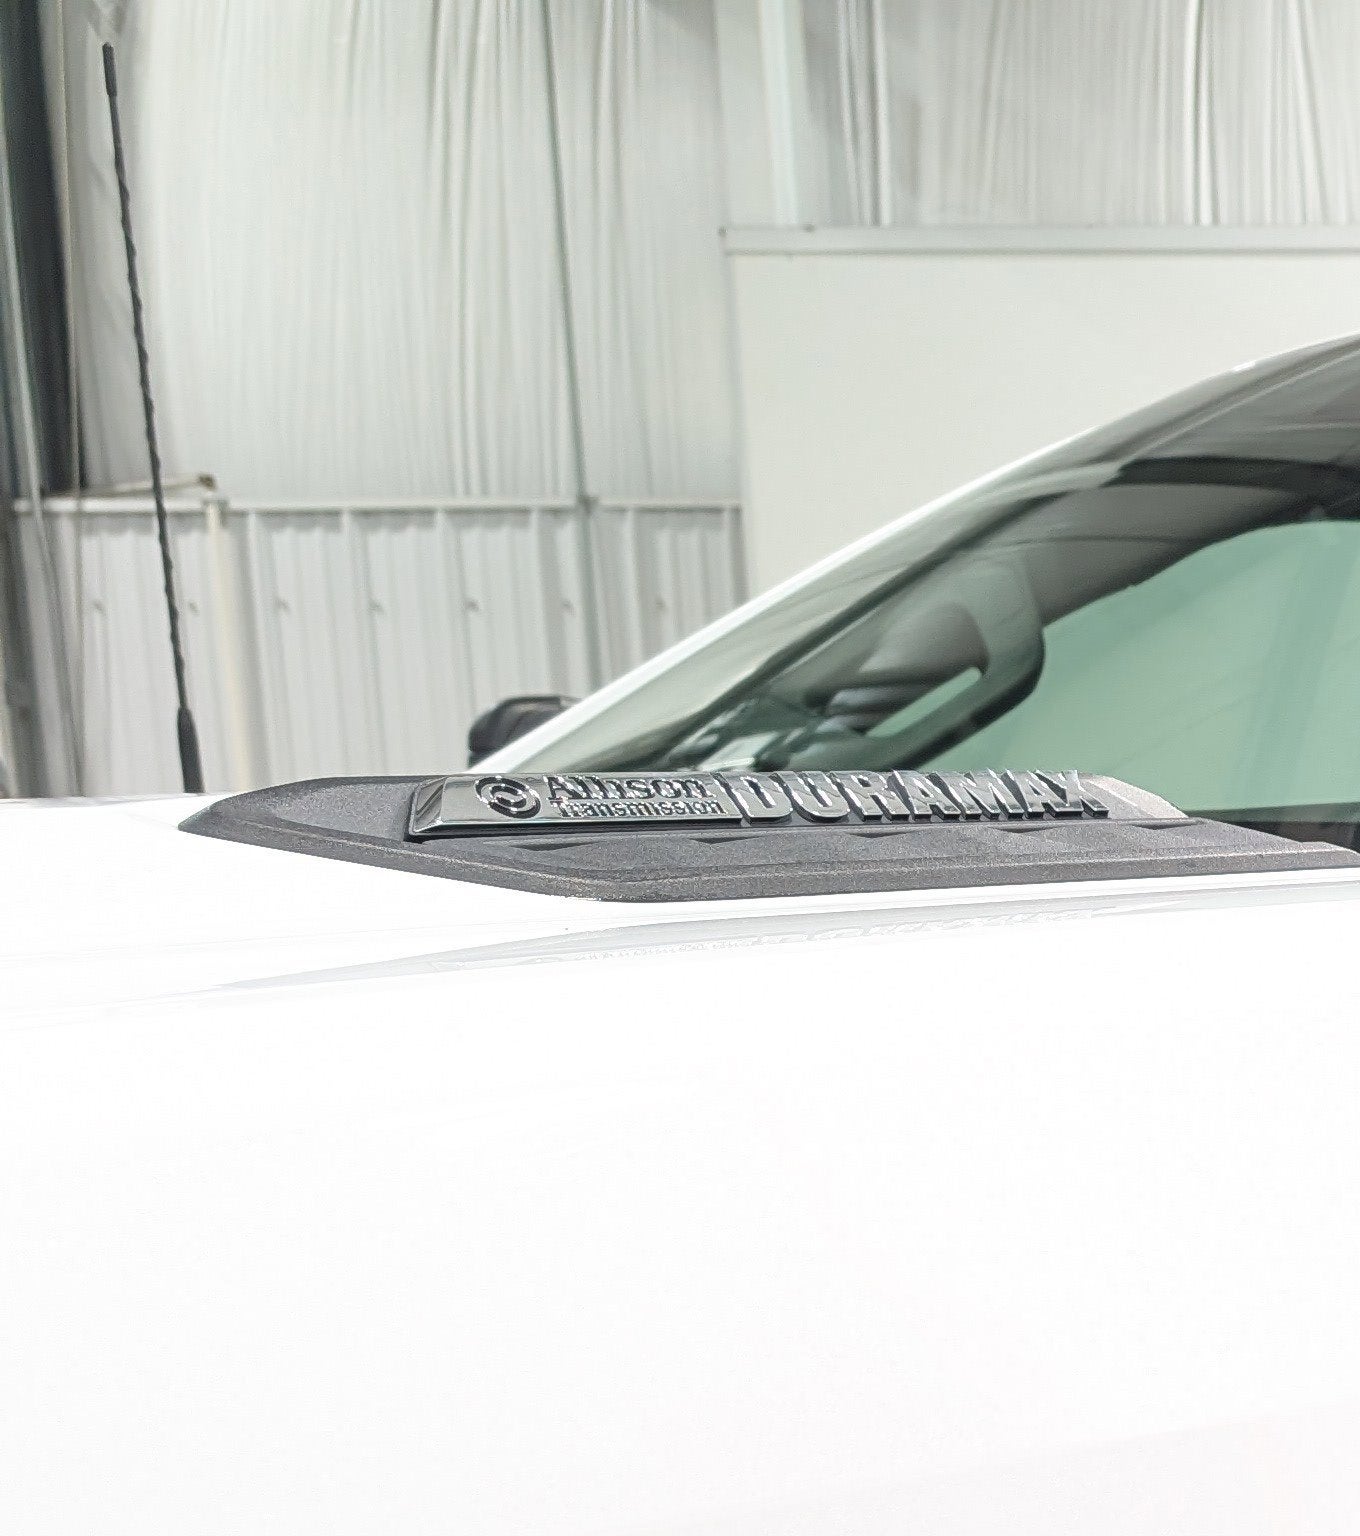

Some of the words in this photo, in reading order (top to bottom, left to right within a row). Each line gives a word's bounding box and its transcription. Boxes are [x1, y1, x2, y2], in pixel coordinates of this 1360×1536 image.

[544, 775, 716, 799] Allison
[712, 770, 1110, 824] DURAMAX
[550, 799, 728, 818] Transmission
